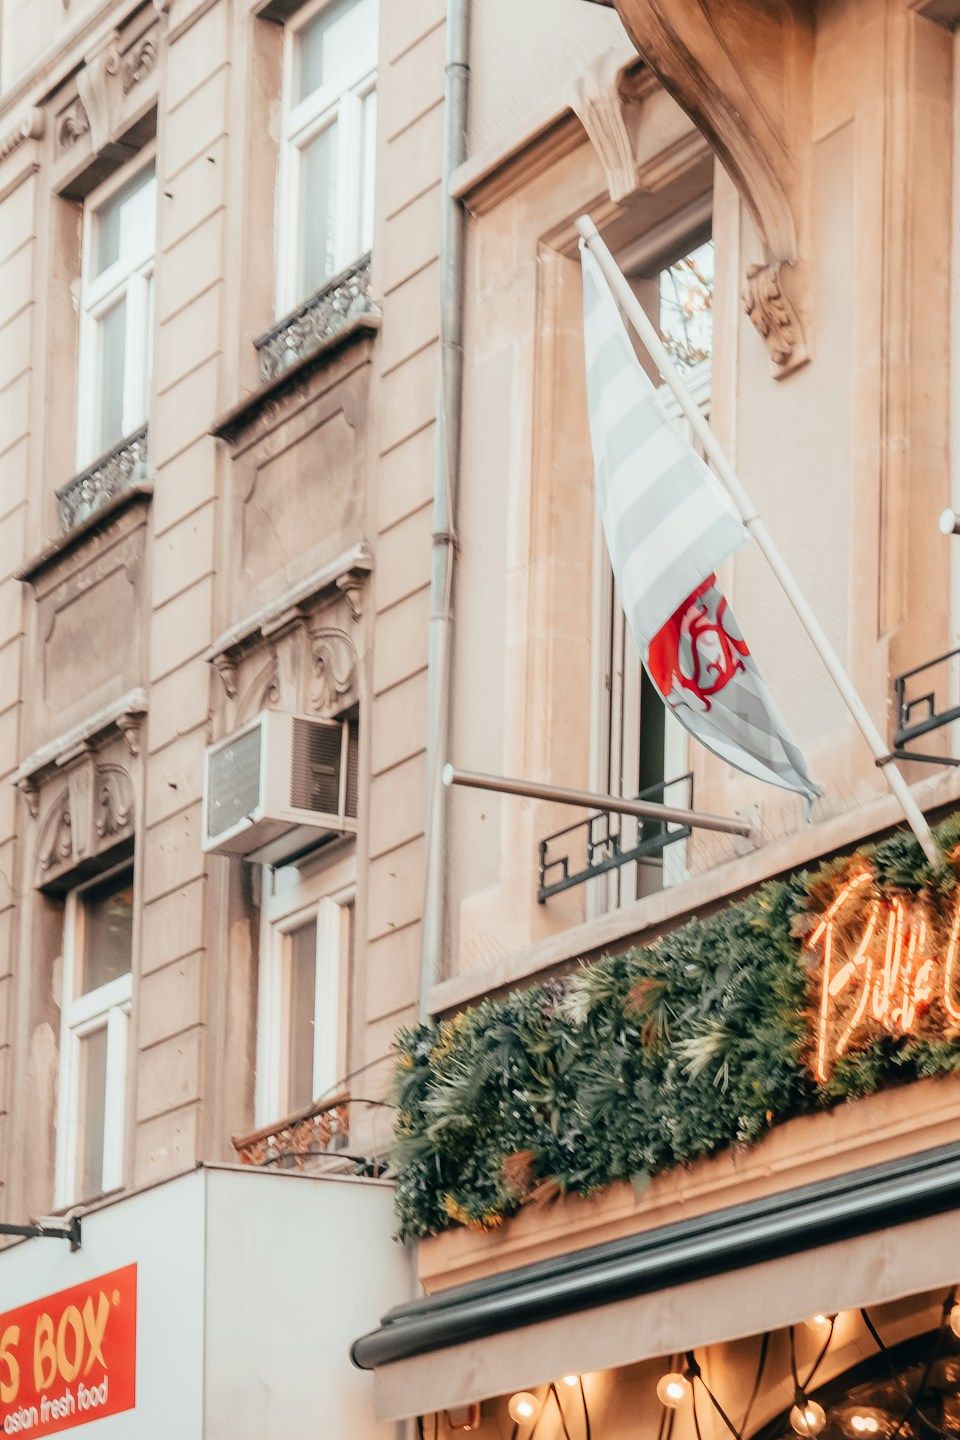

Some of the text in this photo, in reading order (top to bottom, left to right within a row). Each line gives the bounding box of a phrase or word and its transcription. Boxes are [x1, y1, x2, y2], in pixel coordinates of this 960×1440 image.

[34, 1291, 110, 1393] BOX
[4, 1374, 109, 1435] asian fresh food
